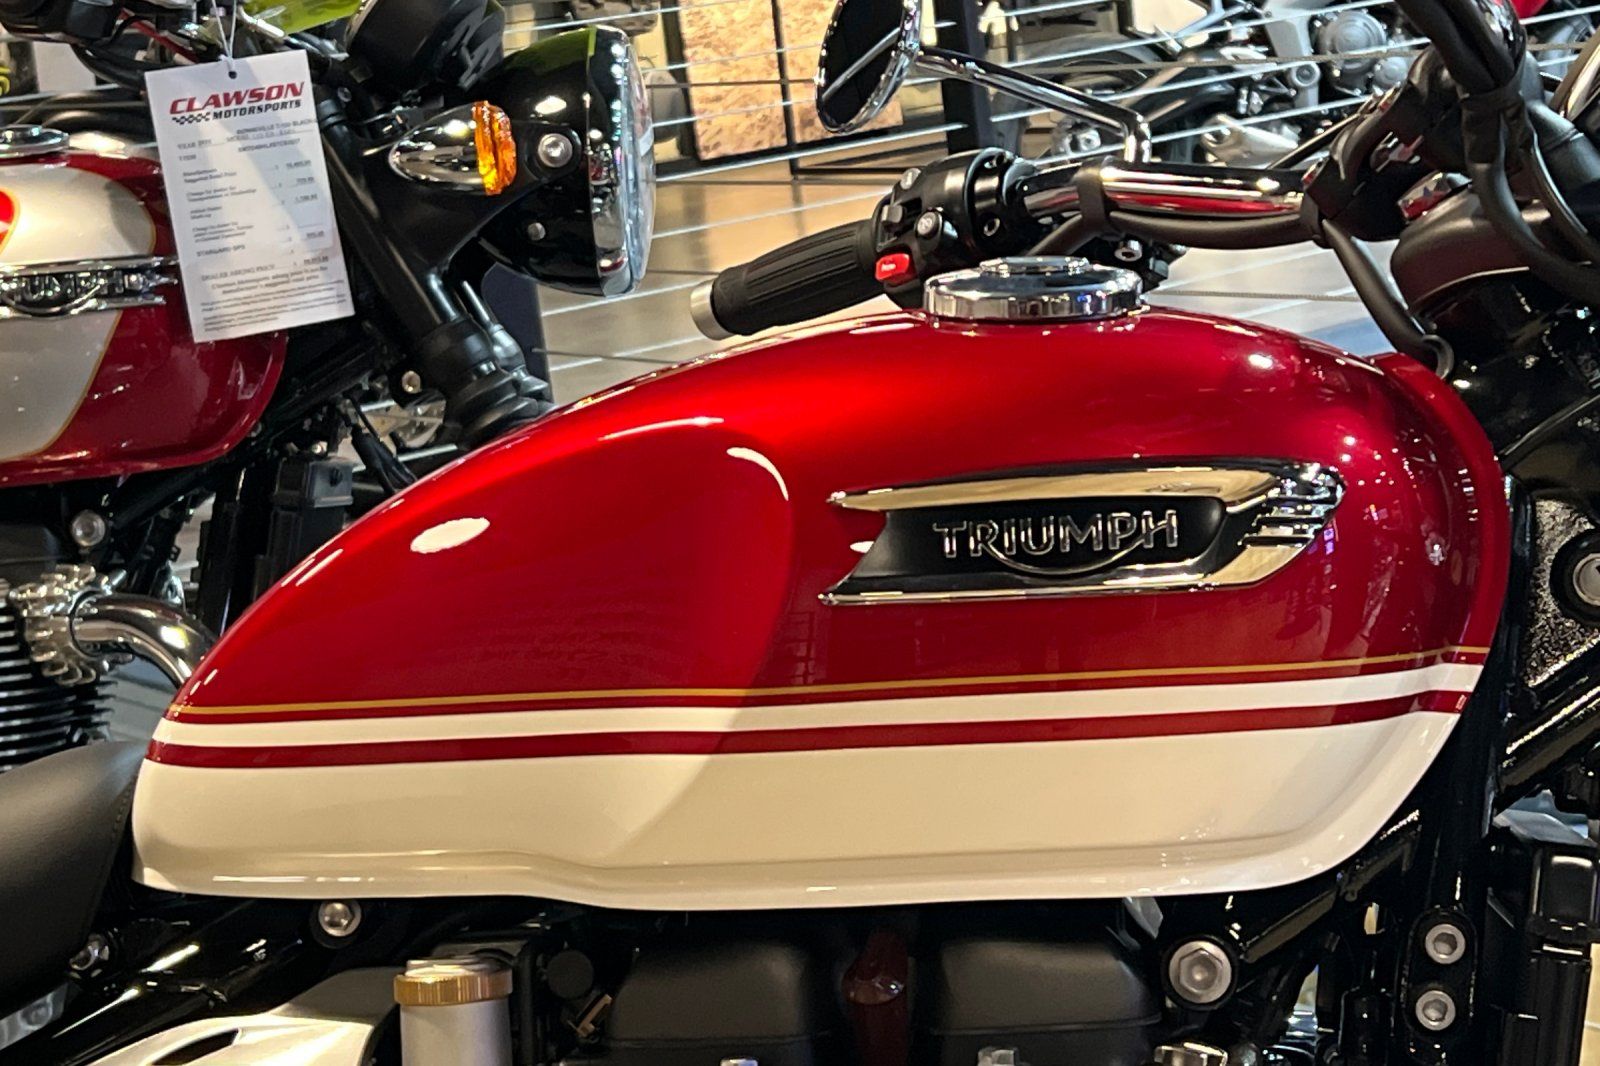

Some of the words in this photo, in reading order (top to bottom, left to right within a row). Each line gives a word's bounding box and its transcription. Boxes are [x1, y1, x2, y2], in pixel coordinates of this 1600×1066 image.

[169, 81, 305, 115] CLAWSON
[212, 99, 301, 121] MOTORSPORTS
[933, 509, 1178, 574] TRIUMPH
